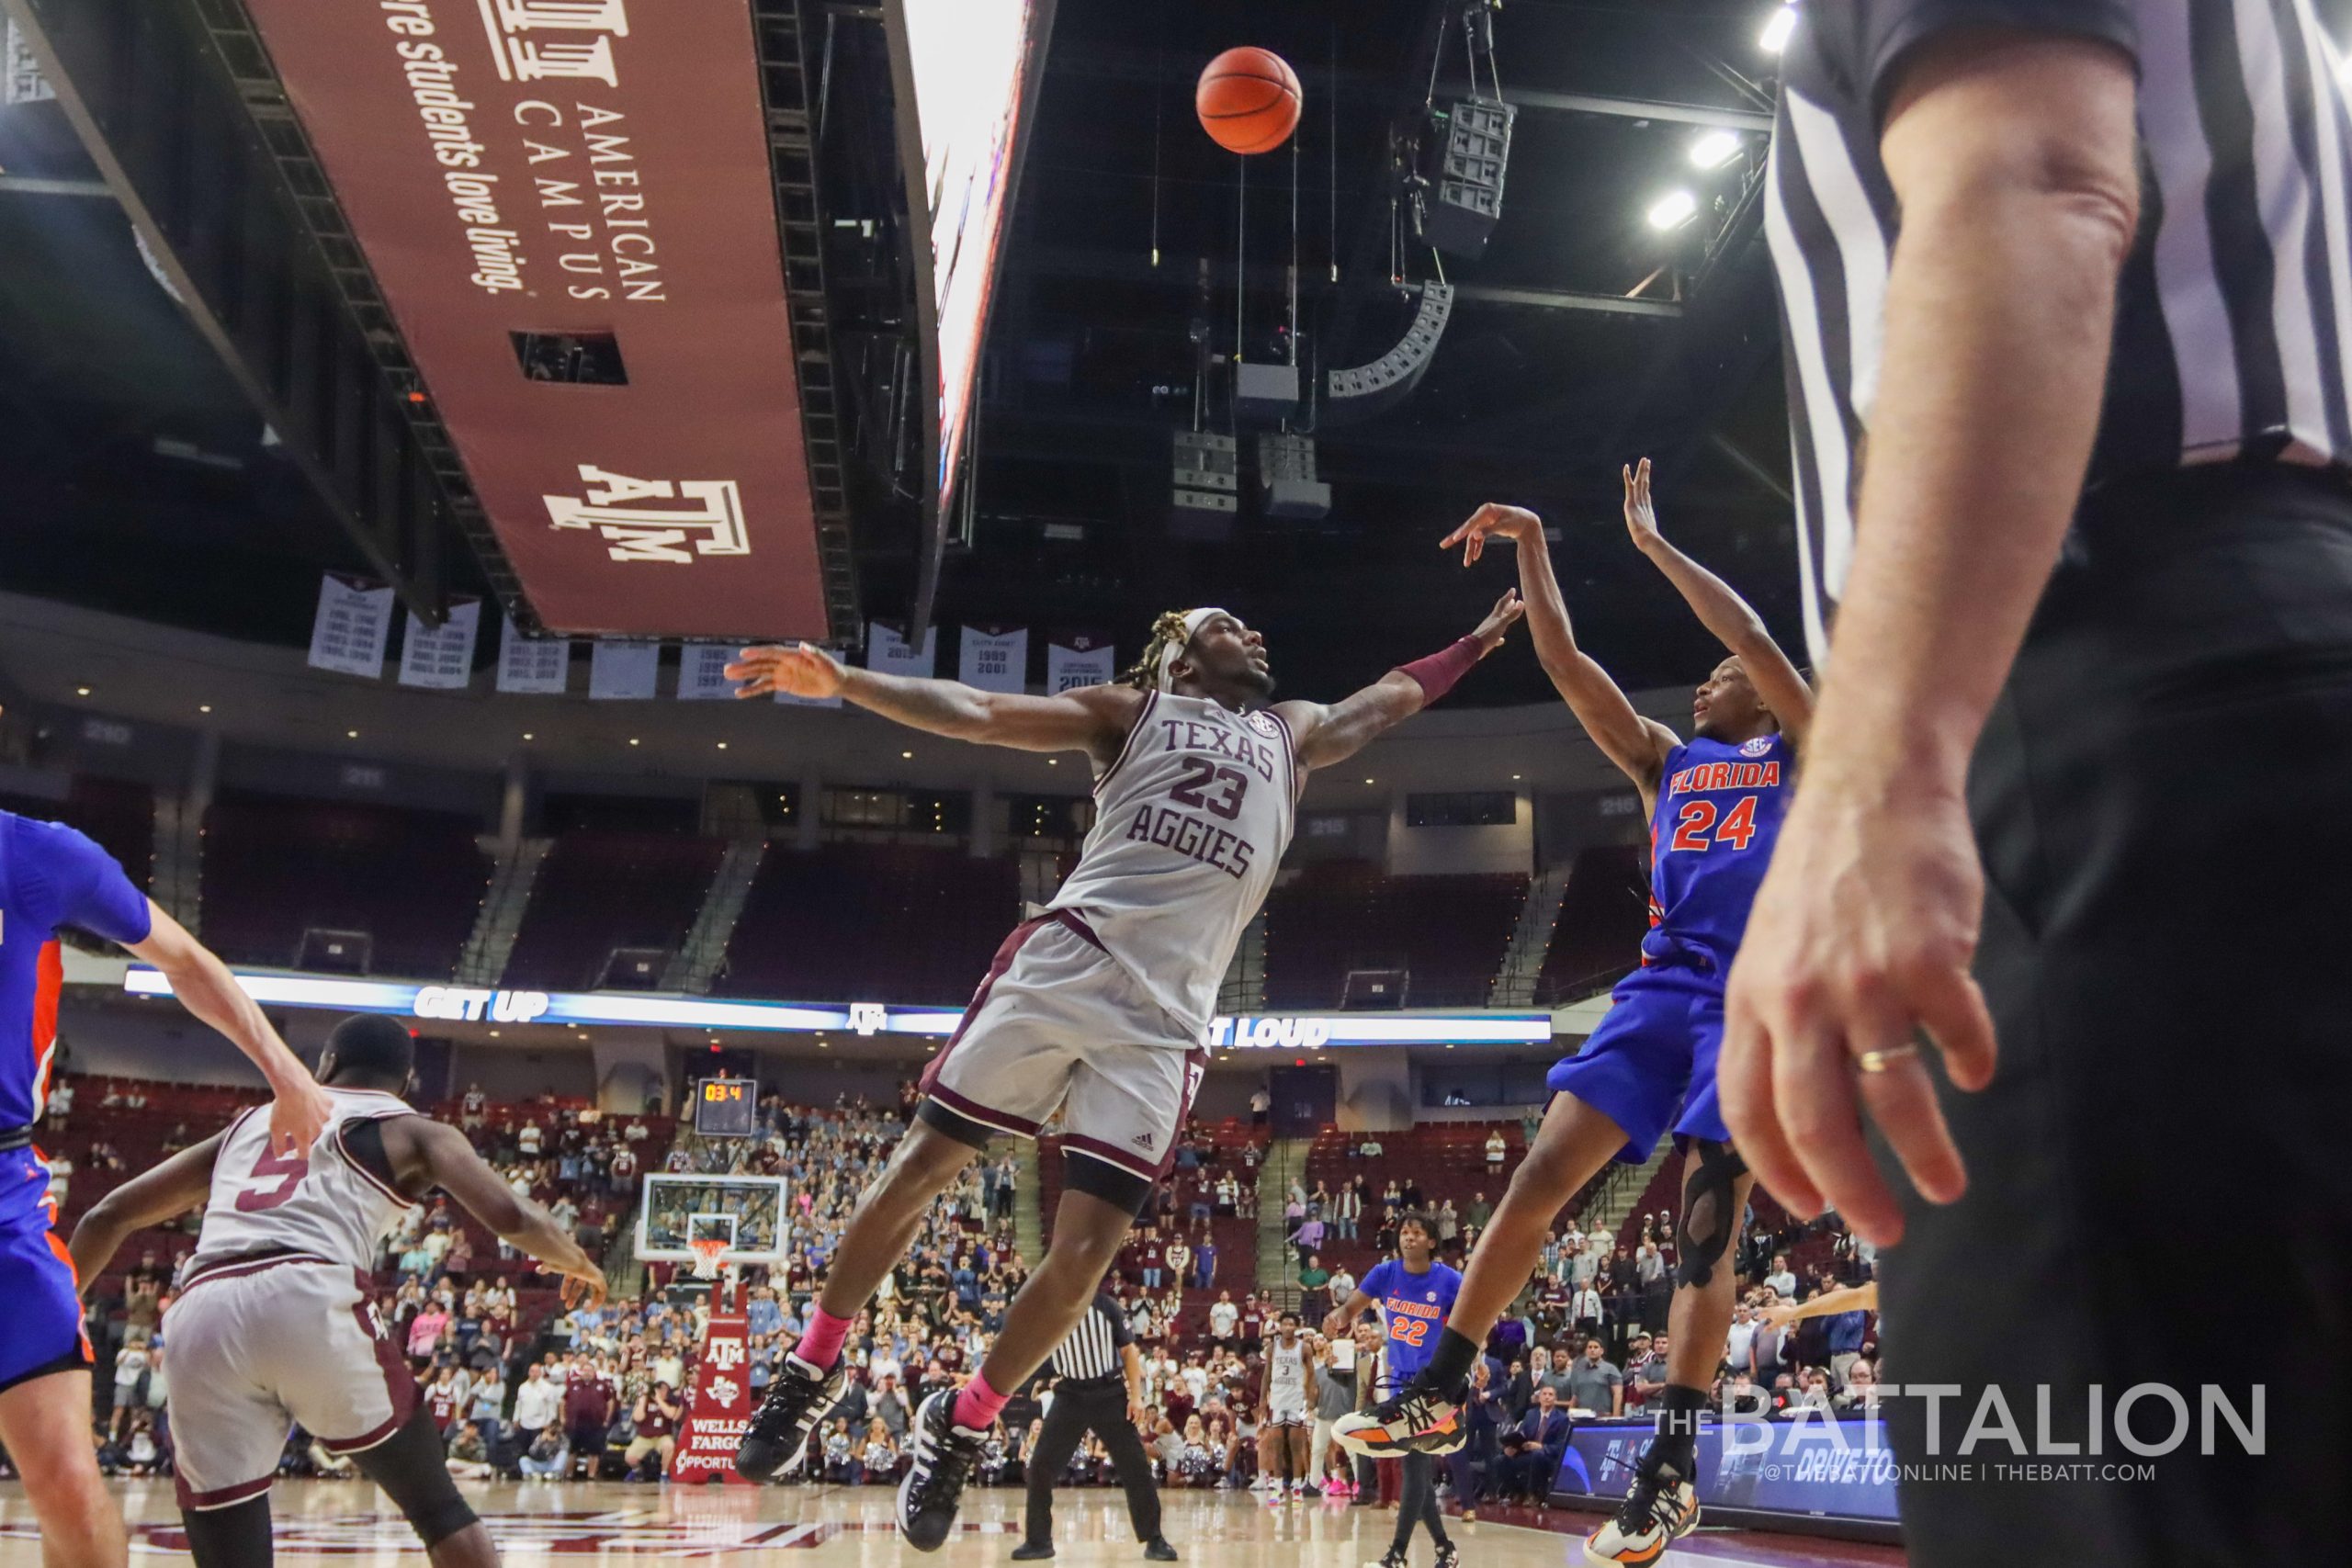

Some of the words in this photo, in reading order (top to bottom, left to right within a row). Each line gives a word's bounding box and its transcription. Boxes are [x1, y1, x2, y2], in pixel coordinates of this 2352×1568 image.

[380, 0, 435, 36] re
[396, 40, 485, 167] students
[445, 171, 499, 224] love
[514, 100, 610, 300] CAMPUS
[575, 101, 666, 302] AMERICAN
[466, 228, 526, 295] living.
[1161, 719, 1274, 783] TEXAS
[1745, 738, 1767, 752] SEC
[1169, 756, 1249, 821] 23
[1668, 761, 1780, 802] FLORIDA
[1126, 805, 1255, 880] AGGIES
[1670, 795, 1758, 852] 24
[413, 986, 492, 1021] GET
[492, 990, 548, 1022] UP
[1234, 1018, 1330, 1047] LOUD
[234, 1132, 322, 1213] 5
[1386, 1297, 1442, 1320] FLORIDA
[1390, 1315, 1429, 1348] 22
[1282, 1365, 1290, 1376] 3
[691, 1419, 749, 1434] WELLS
[1794, 1448, 1863, 1483] DRIVE
[1860, 1449, 1894, 1485] TO
